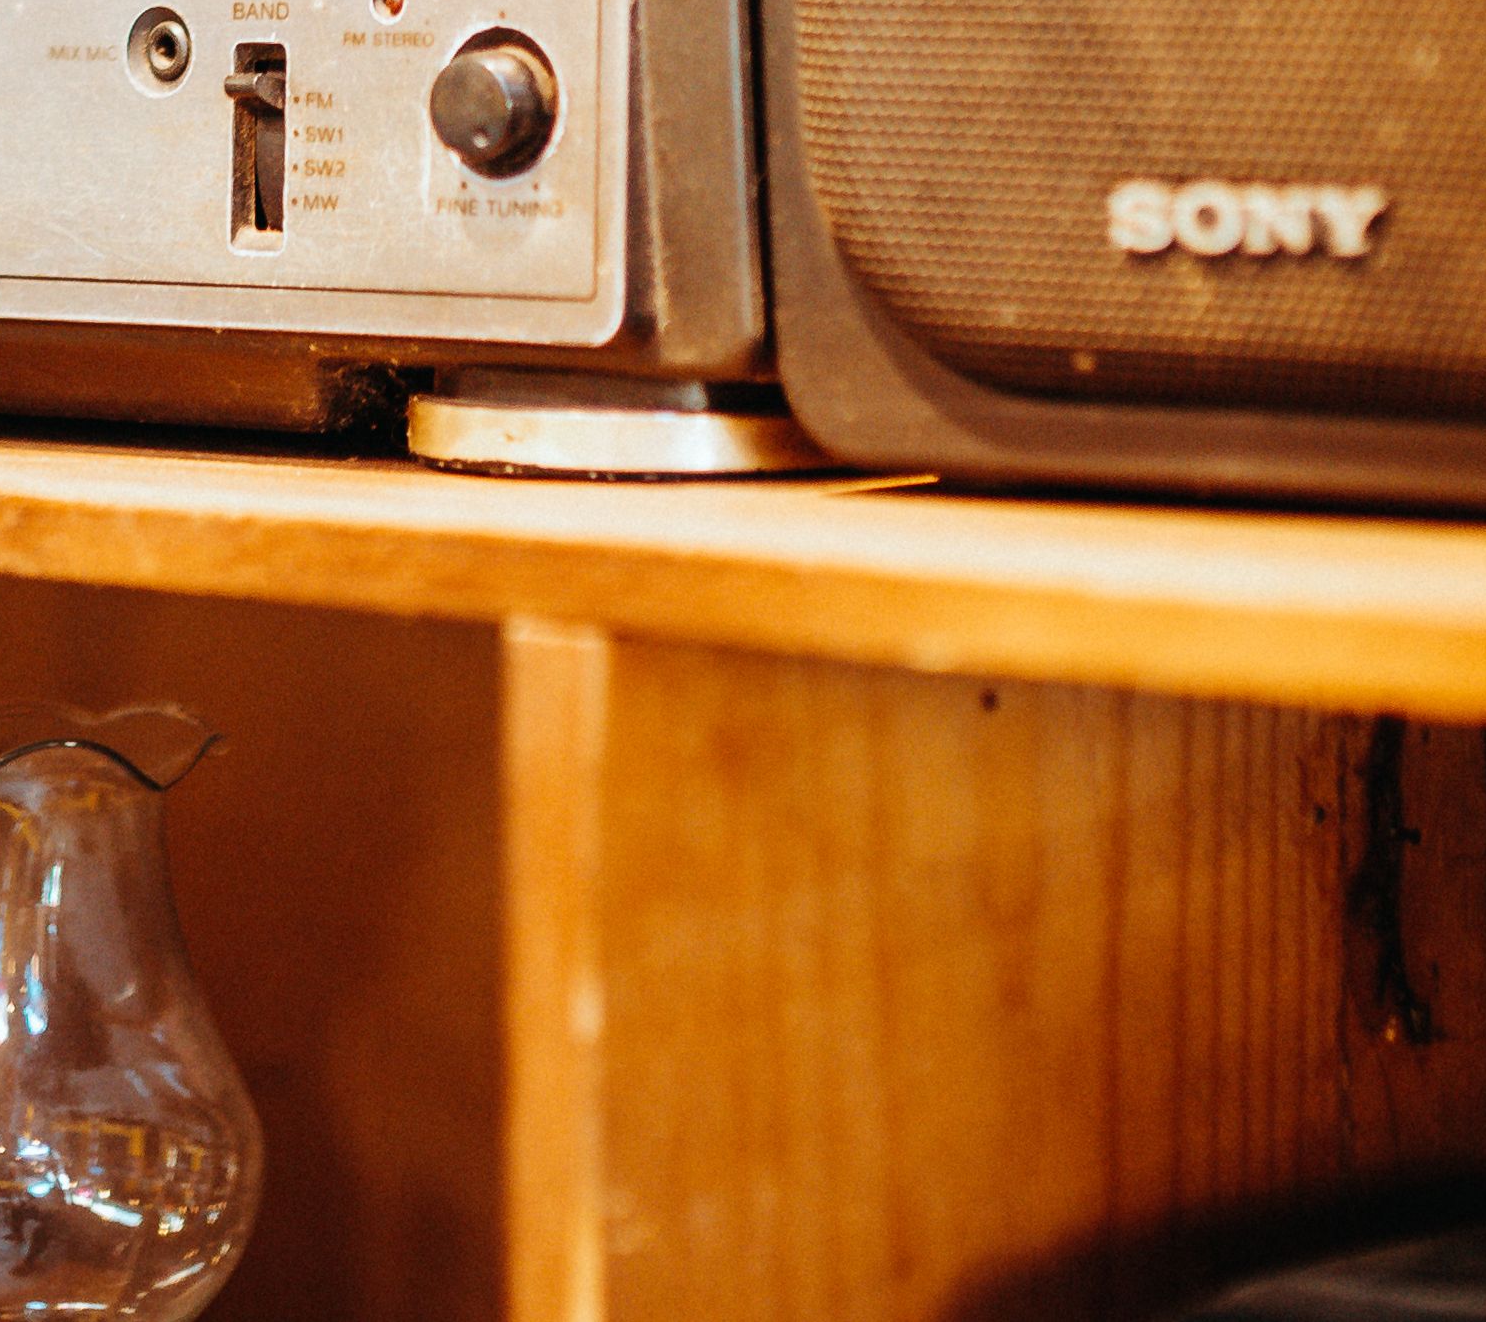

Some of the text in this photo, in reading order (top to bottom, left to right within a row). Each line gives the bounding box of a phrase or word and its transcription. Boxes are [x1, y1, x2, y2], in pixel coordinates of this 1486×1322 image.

[232, 2, 290, 21] BAND
[343, 31, 434, 47] FM STEREO
[48, 45, 118, 61] MIX MIC
[305, 93, 333, 109] FM
[306, 126, 344, 143] SW1
[304, 160, 345, 178] SW2
[303, 195, 338, 211] MW
[437, 198, 564, 218] FINE TUNING
[1106, 178, 1385, 256] SONY
